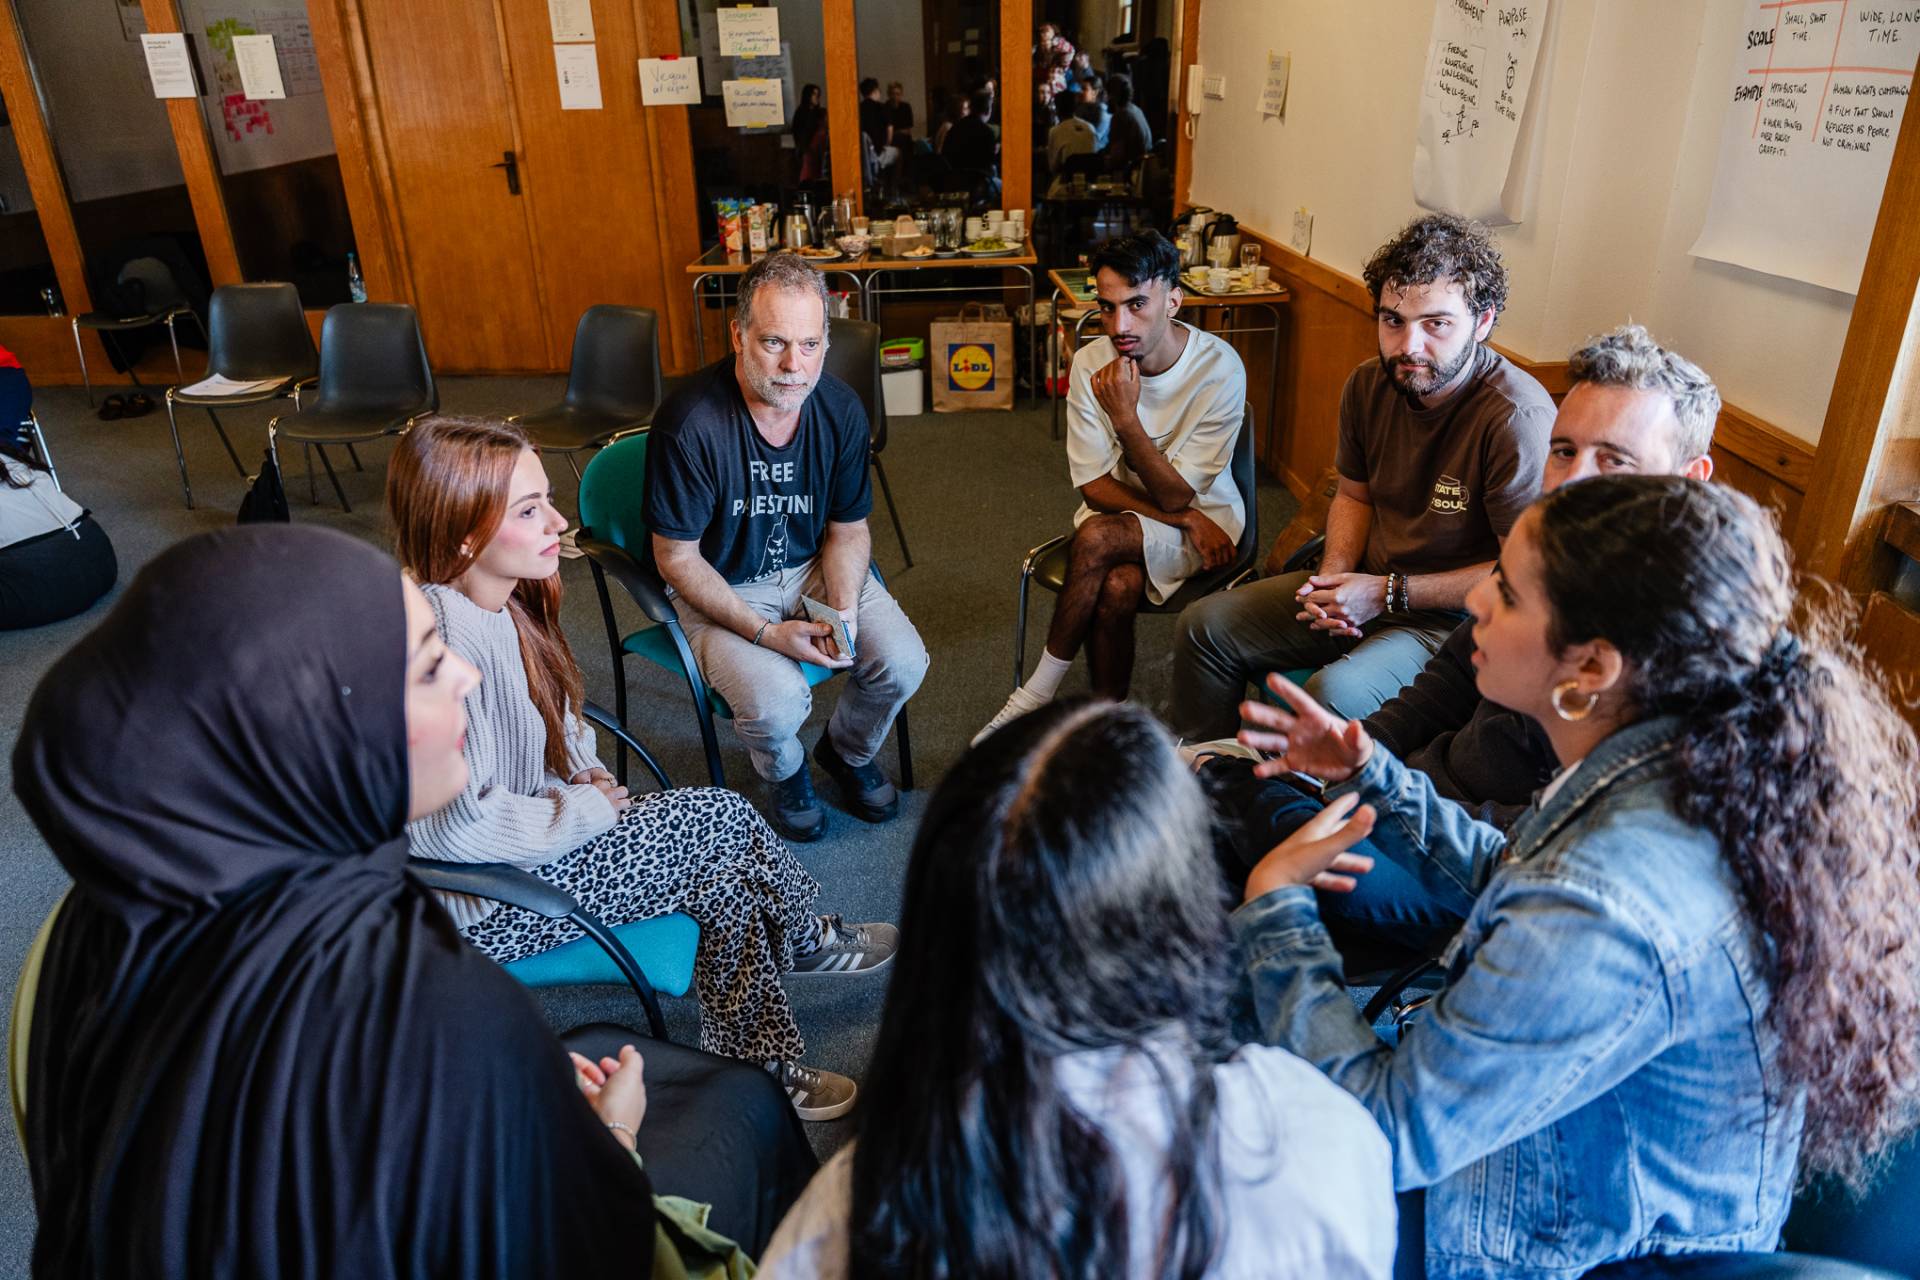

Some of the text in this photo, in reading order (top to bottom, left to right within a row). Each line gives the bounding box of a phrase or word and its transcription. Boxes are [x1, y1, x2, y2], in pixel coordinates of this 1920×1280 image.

[1499, 7, 1527, 26] PURPOSE
[1890, 9, 1920, 23] LONG
[1747, 28, 1775, 49] SCALE
[1833, 83, 1854, 95] HUMAN
[1855, 84, 1877, 97] RIGHTS
[1834, 104, 1852, 118] FILM
[1825, 121, 1854, 135] REFUGEES
[1822, 138, 1834, 149] NOT
[749, 461, 794, 482] FREE
[732, 494, 813, 518] PALESTIN
